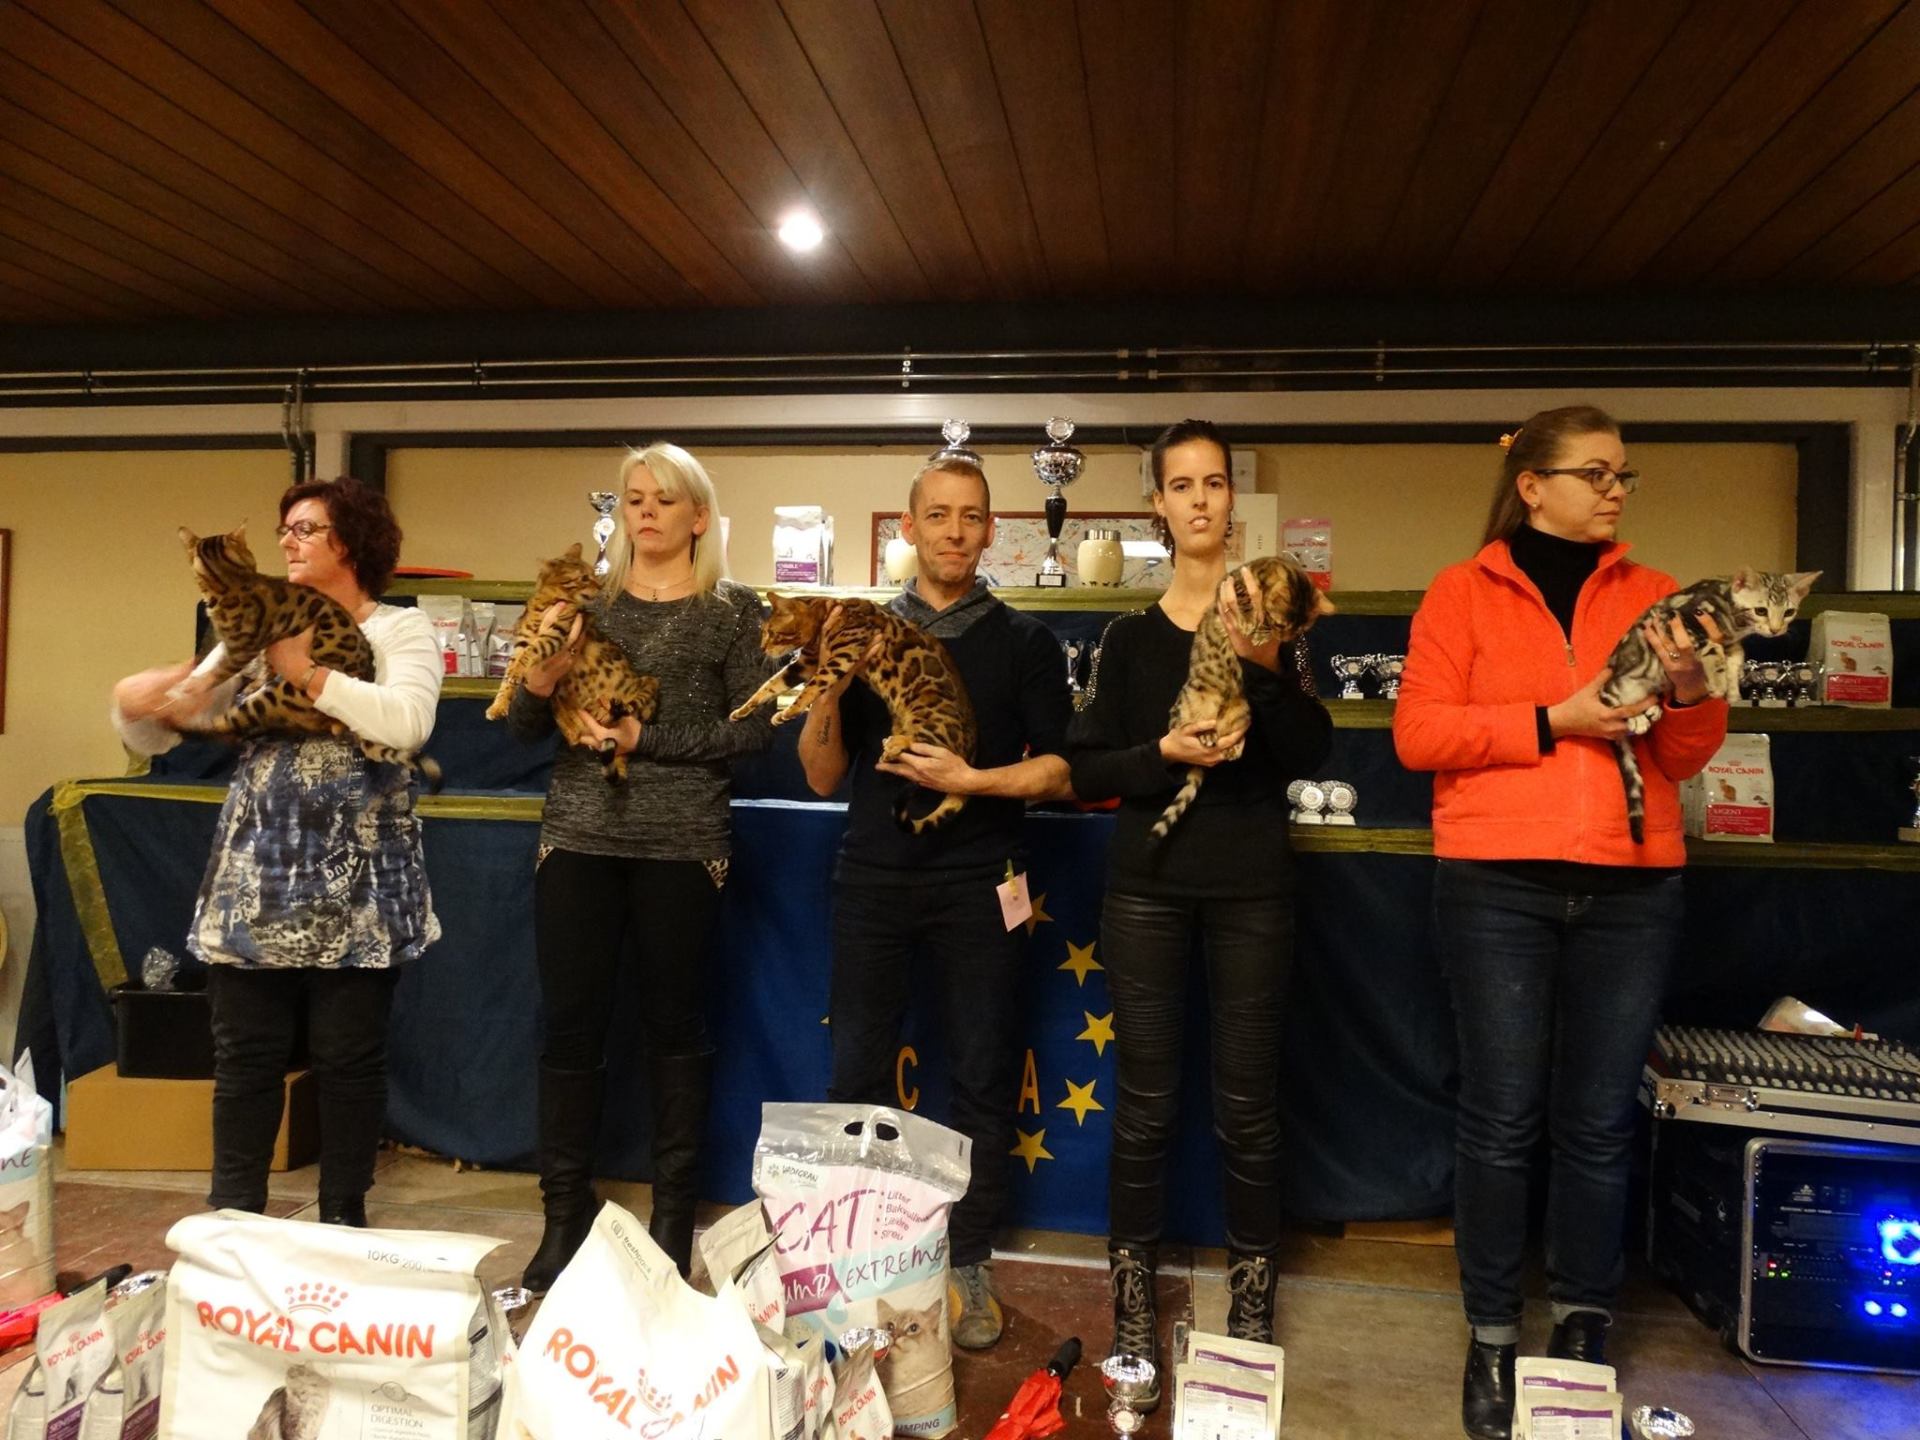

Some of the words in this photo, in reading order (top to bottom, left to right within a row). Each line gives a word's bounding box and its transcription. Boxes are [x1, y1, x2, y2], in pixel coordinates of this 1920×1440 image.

[1708, 765, 1734, 774] ROYAL
[1736, 767, 1765, 775] CANIN
[773, 1189, 876, 1254] CAT
[367, 1249, 400, 1264] 10KG
[196, 1301, 300, 1352] ROYAL
[309, 1321, 435, 1358] CANIN
[542, 1327, 632, 1429] ROYAL
